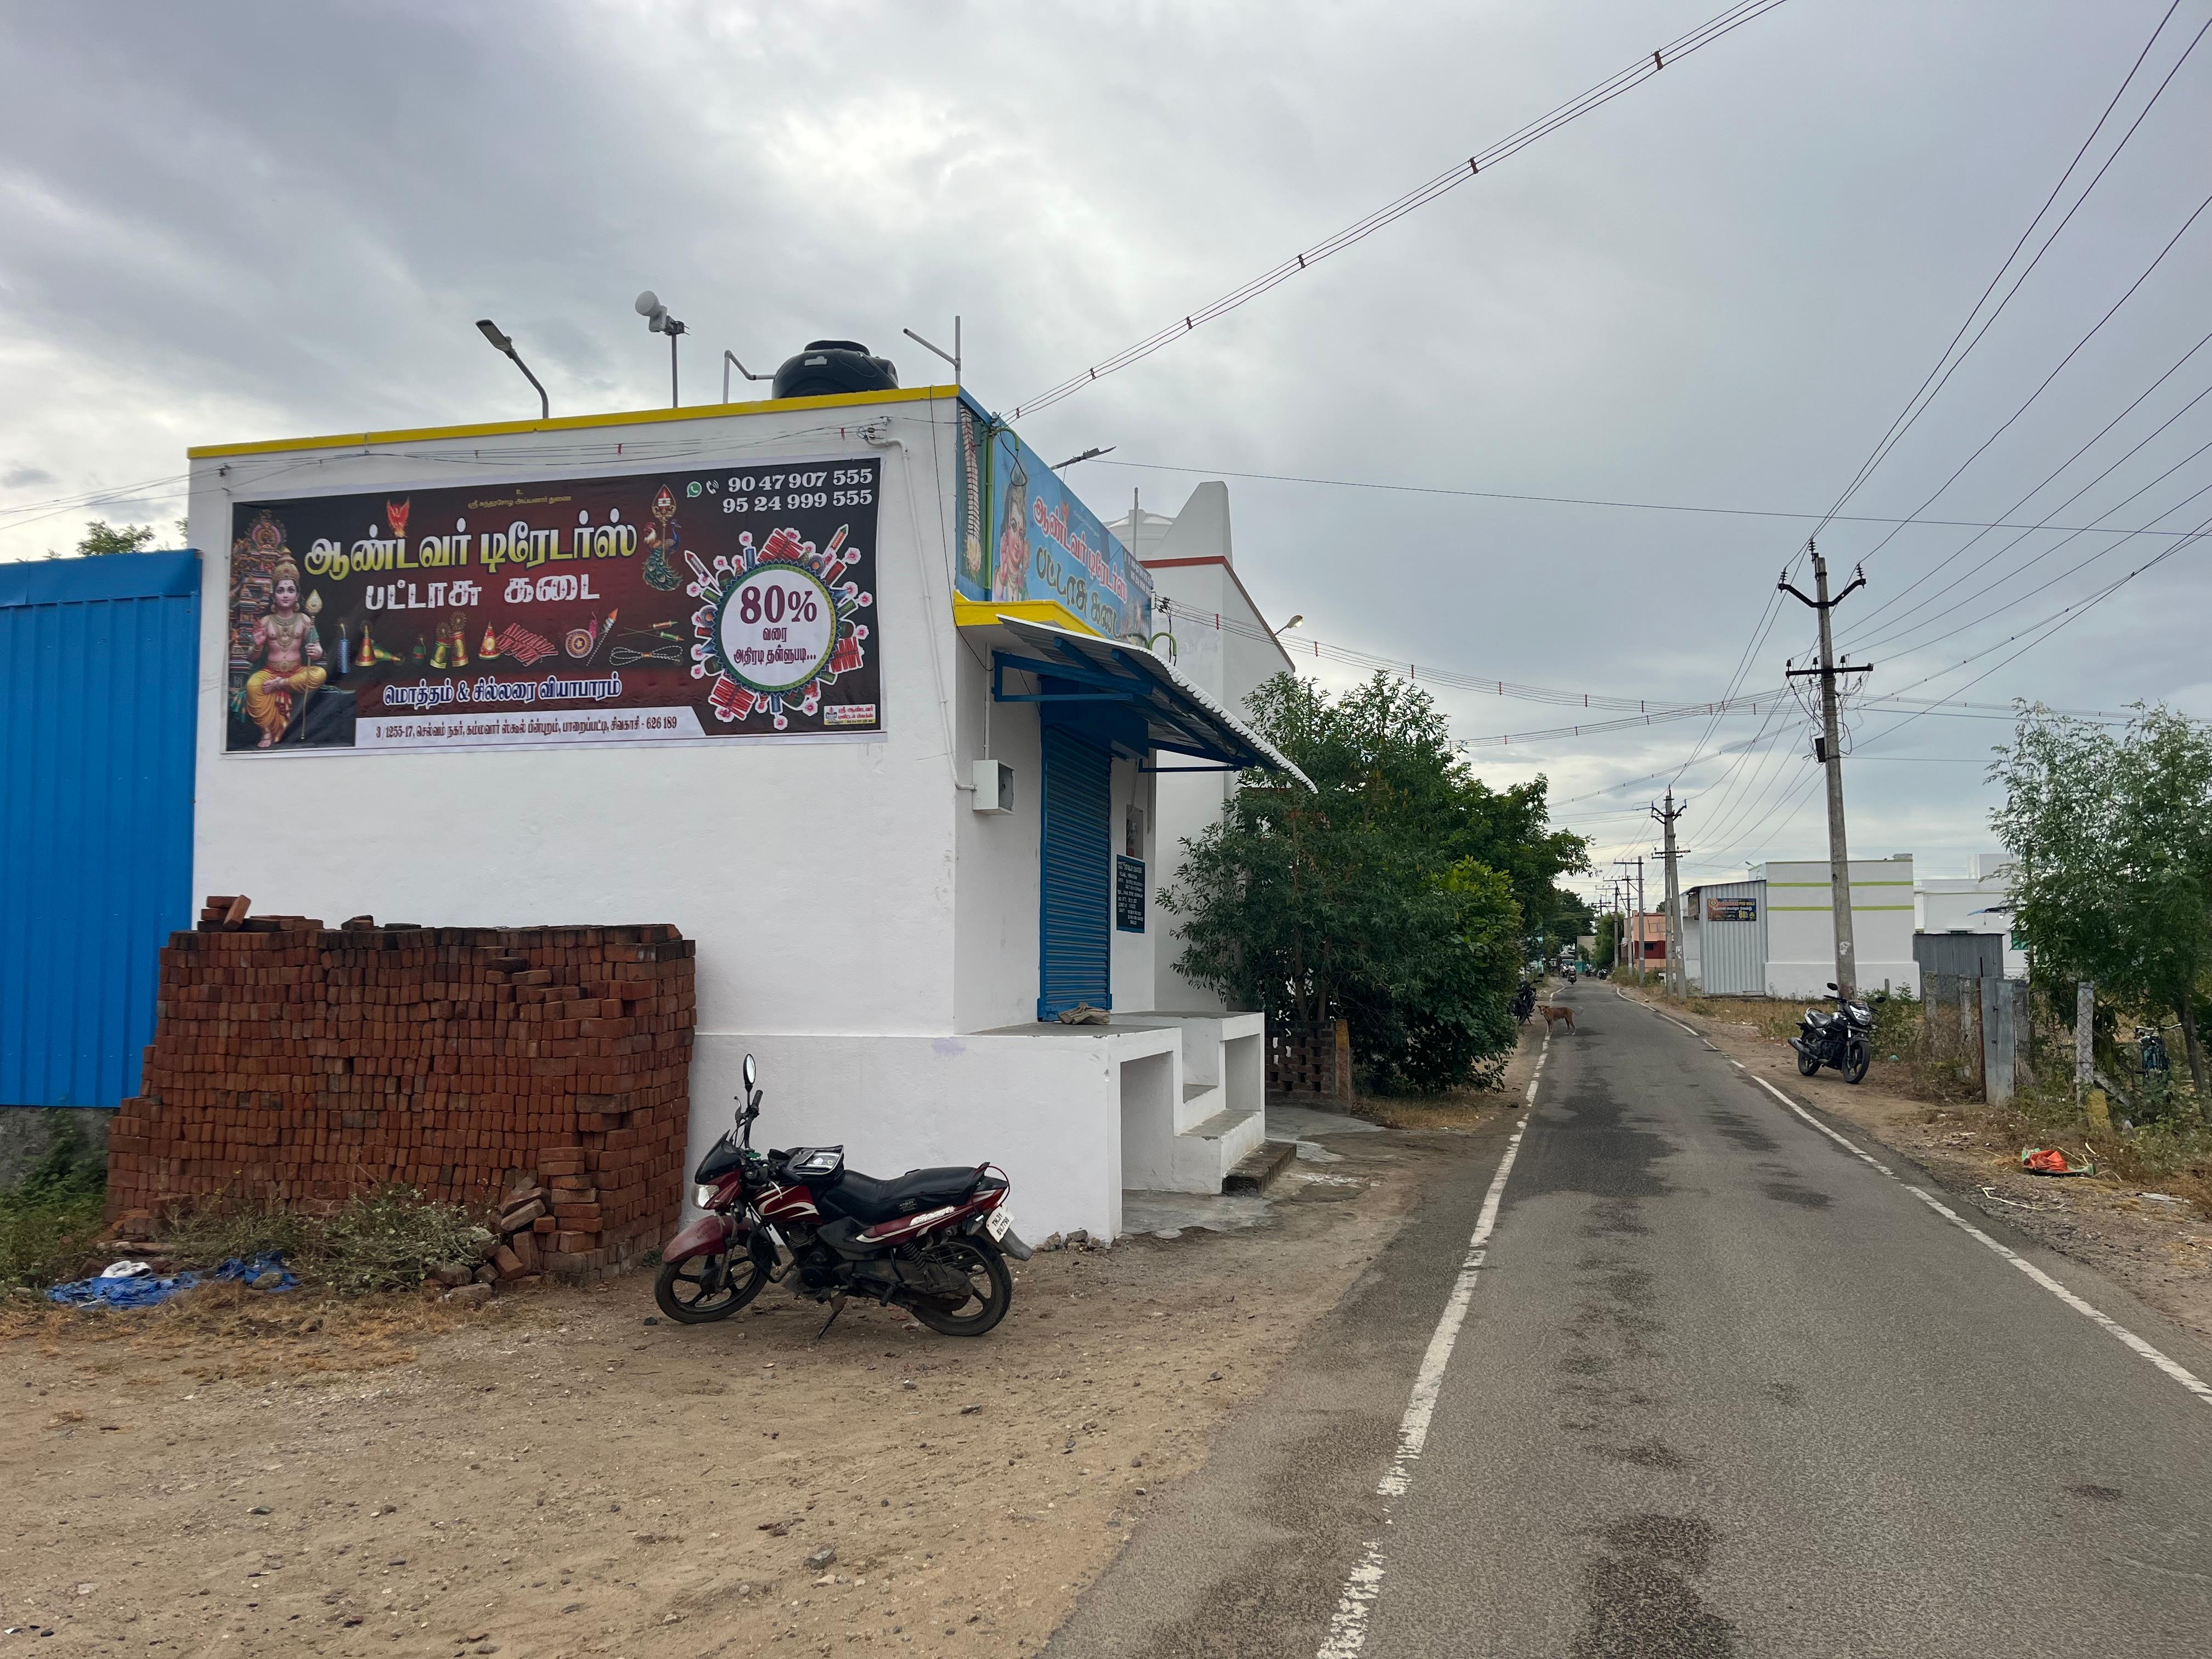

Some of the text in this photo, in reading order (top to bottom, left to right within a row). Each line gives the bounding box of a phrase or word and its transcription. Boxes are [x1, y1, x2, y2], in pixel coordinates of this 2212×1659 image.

[728, 469, 872, 492] 90 47 907 555
[723, 489, 872, 513] 95 24 999 555
[304, 508, 637, 580] ஆண்டவர் டிரேடர்ஸ்
[1033, 495, 1088, 566] ஆண்டவர்
[1088, 548, 1127, 604] டிரேடர்ஸ்
[365, 574, 601, 610] பட்டாசு கடை
[741, 585, 817, 624] 80%
[1036, 546, 1121, 640] பட்டாசு கடை
[763, 627, 788, 642] வரை
[733, 647, 765, 667] அதிரடி
[385, 672, 622, 709] மொத்தம் & சில்லரை வியாபாரம்
[611, 715, 640, 731] சிவகாசி
[646, 716, 662, 730] 626
[663, 716, 678, 730] 189
